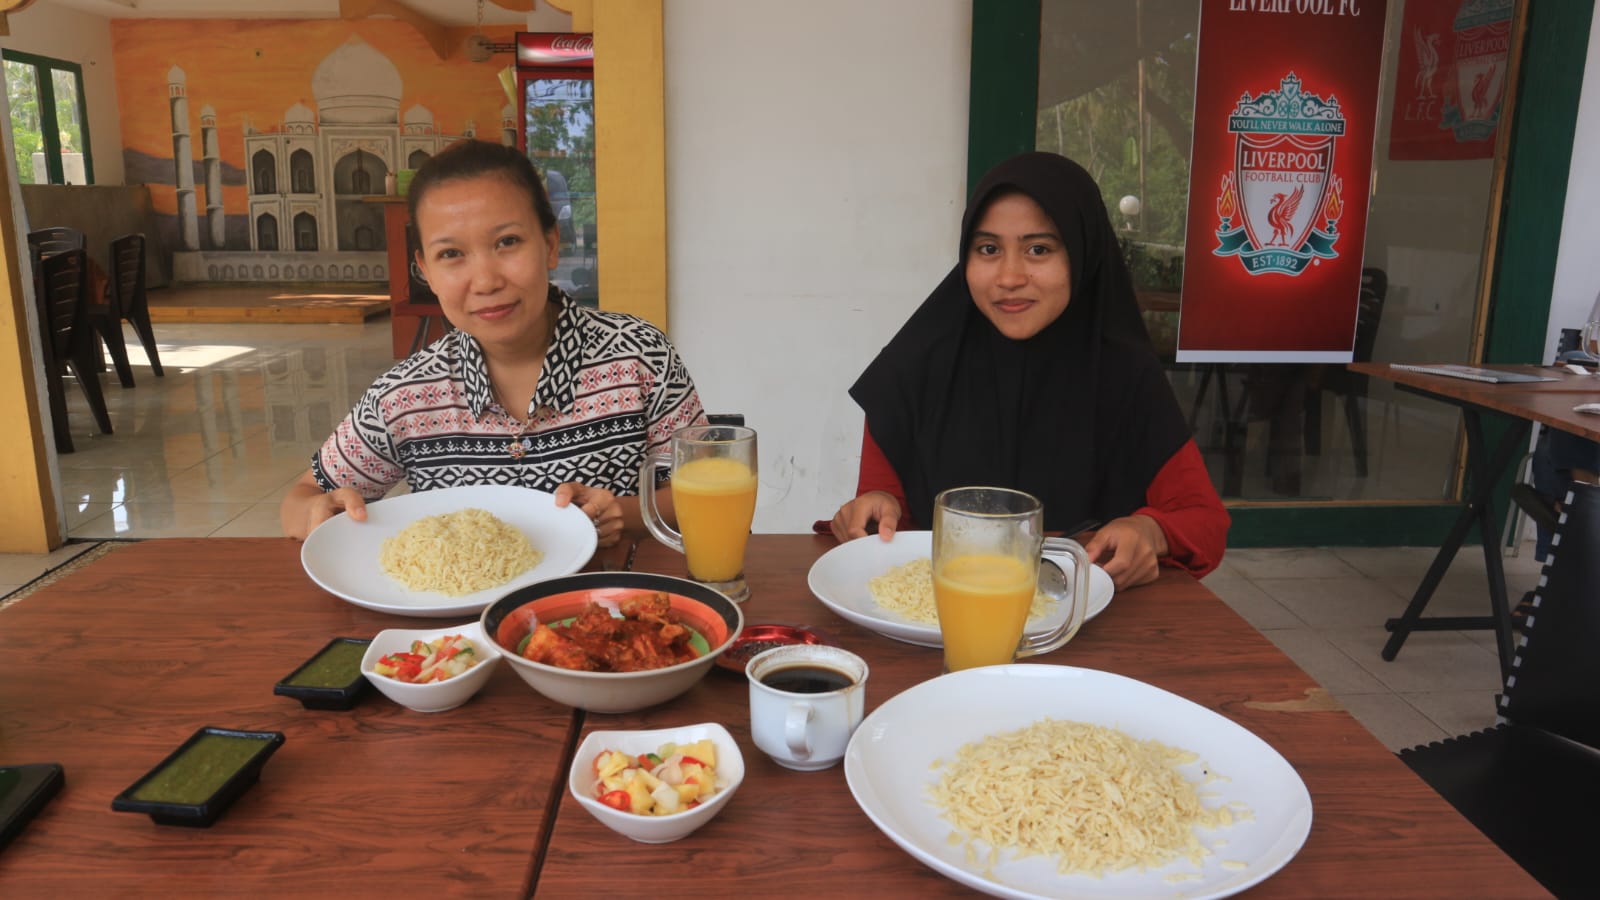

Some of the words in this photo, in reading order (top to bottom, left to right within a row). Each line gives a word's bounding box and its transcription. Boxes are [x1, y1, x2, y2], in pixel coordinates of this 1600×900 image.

[1231, 119, 1259, 129] YOU'LL
[1260, 120, 1287, 130] NEVER
[1288, 121, 1312, 131] WALK
[1312, 122, 1343, 133] ALONE
[1243, 151, 1326, 169] LIVERPOOL
[1245, 172, 1294, 183] FOOTBALL
[1296, 173, 1321, 184] CLUB
